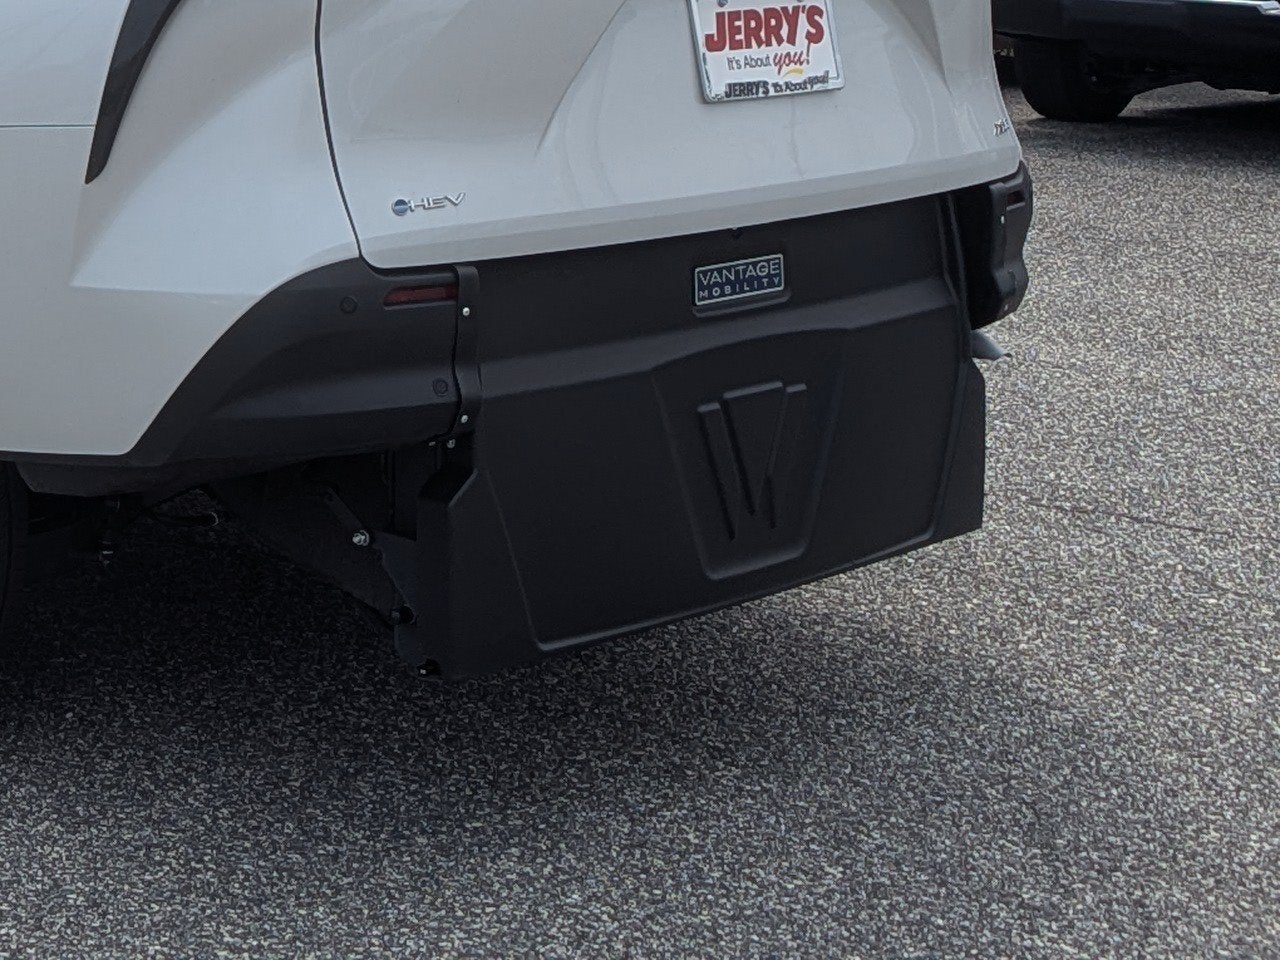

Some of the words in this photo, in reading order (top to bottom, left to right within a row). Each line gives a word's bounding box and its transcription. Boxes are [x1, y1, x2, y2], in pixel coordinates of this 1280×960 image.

[704, 4, 825, 53] JERRY'S
[726, 56, 742, 71] It's
[743, 55, 771, 69] About
[772, 43, 811, 76] you!
[408, 192, 466, 213] HEV
[699, 260, 780, 286] VANTAGE
[699, 277, 780, 299] MOBILITY
